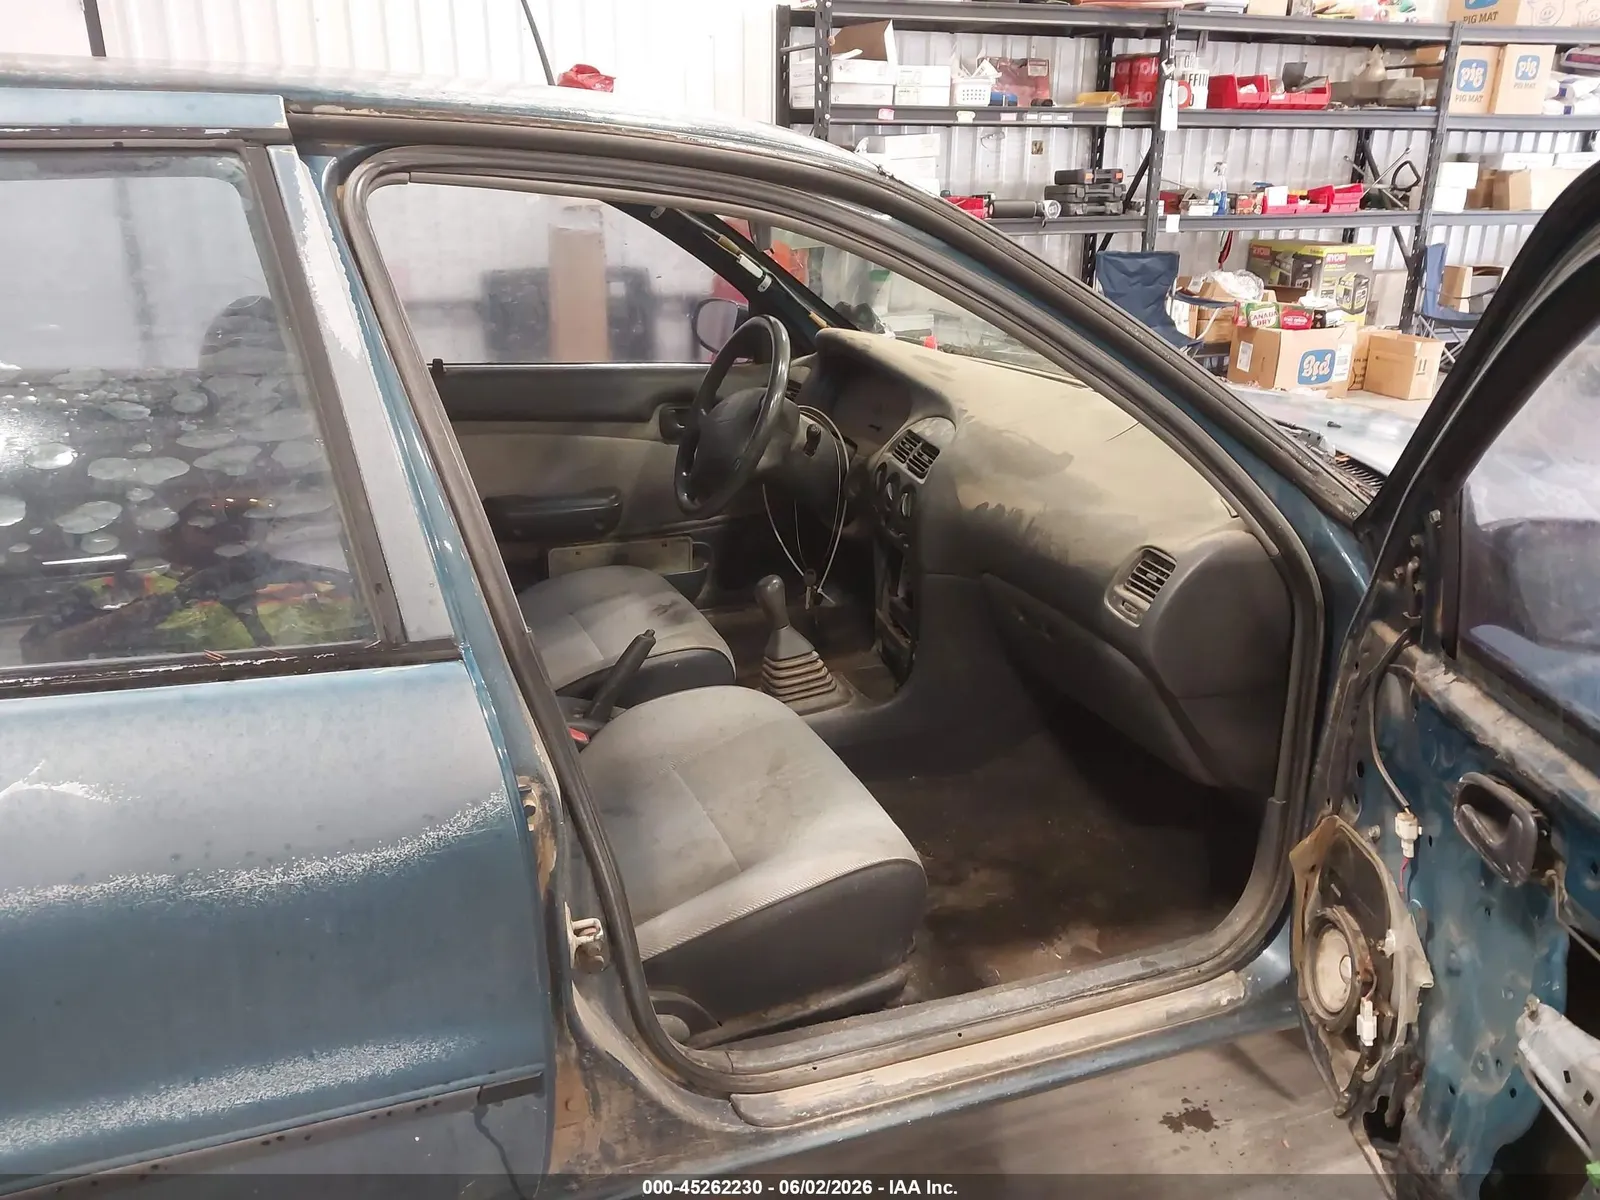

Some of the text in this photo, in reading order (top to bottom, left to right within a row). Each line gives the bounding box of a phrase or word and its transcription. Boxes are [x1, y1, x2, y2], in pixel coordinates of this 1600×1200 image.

[1463, 11, 1498, 24] PIG MAT
[1455, 94, 1484, 103] PIG MAT
[1249, 311, 1279, 321] CANADA
[1256, 318, 1272, 327] DRY
